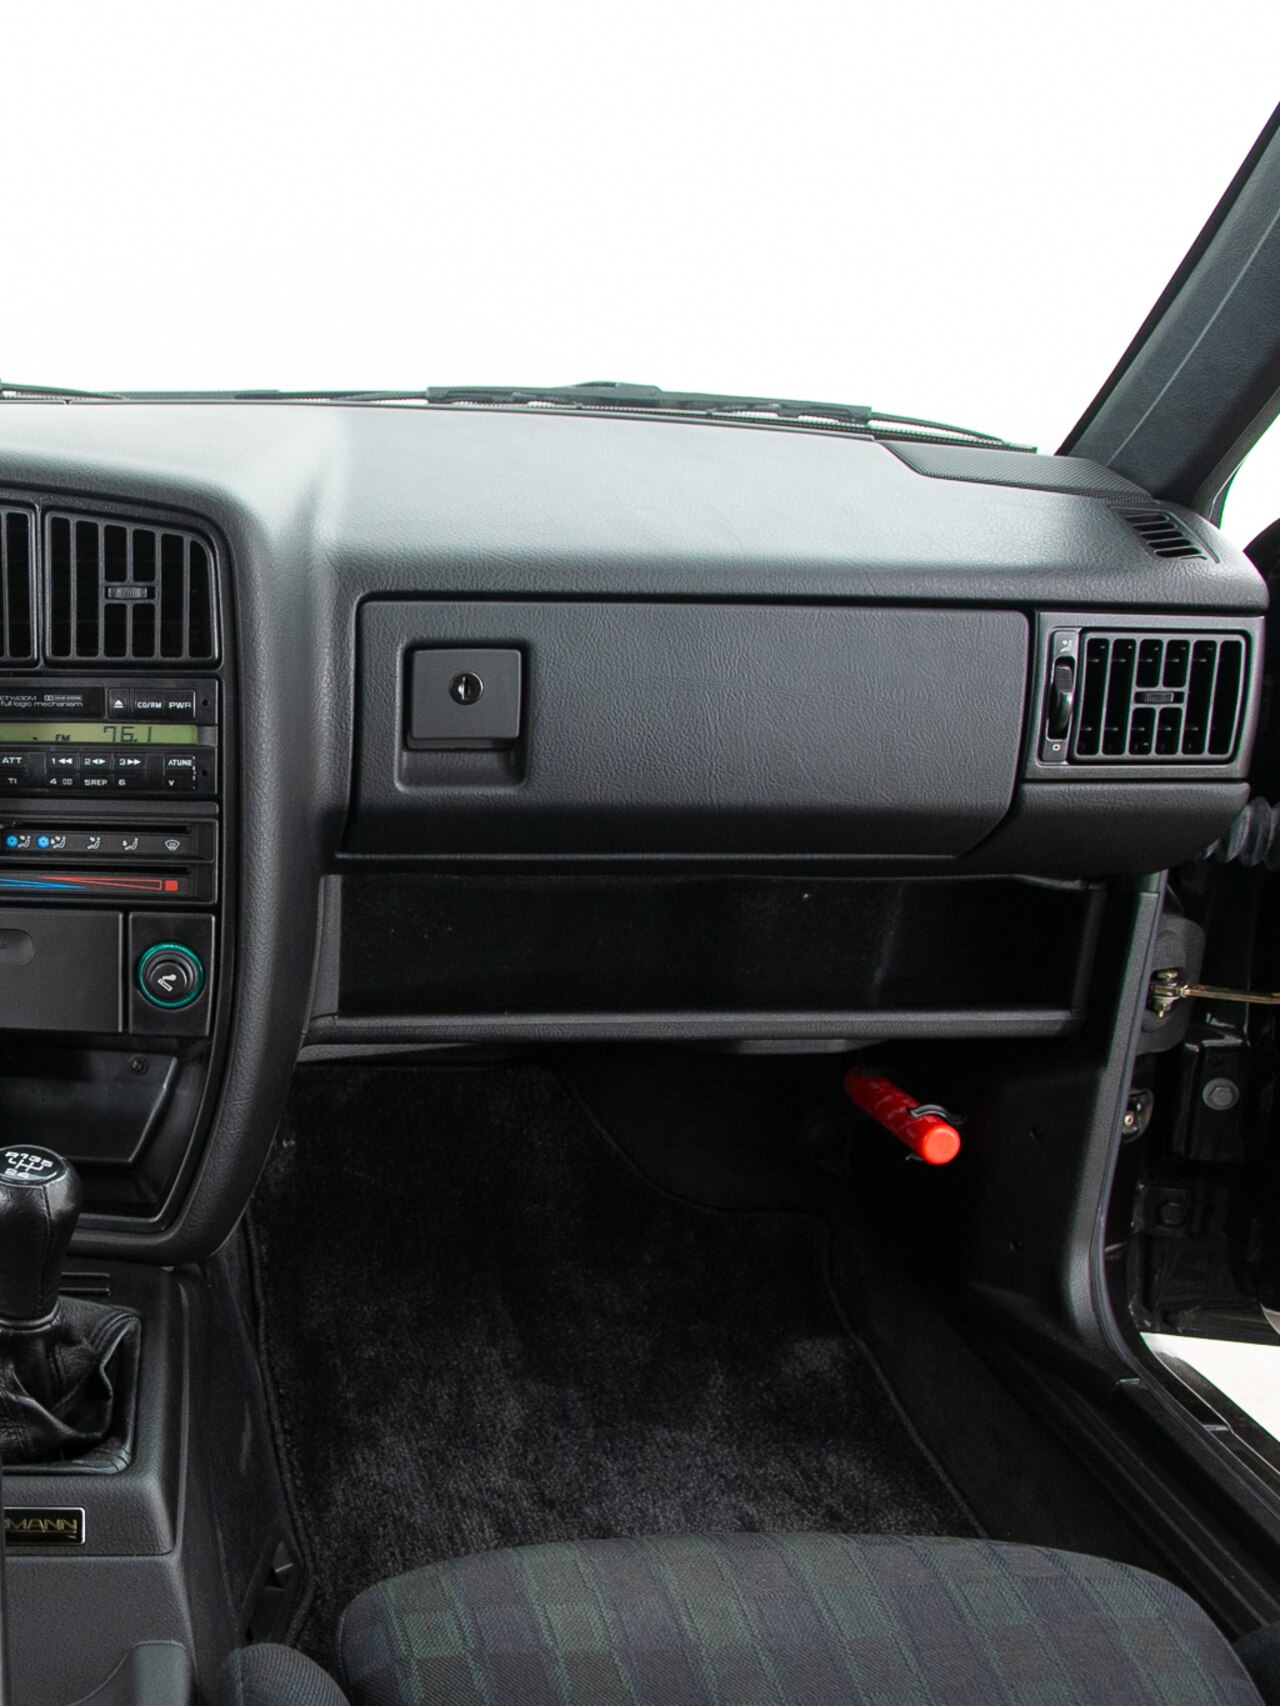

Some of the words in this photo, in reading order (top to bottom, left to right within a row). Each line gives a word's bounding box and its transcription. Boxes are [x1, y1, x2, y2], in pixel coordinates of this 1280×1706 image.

[14, 700, 32, 709] logic
[55, 734, 70, 742] FM
[103, 726, 153, 743] 76.1
[51, 757, 56, 765] 1
[84, 758, 91, 766] 2
[119, 758, 126, 766] 3
[50, 777, 57, 785] 4
